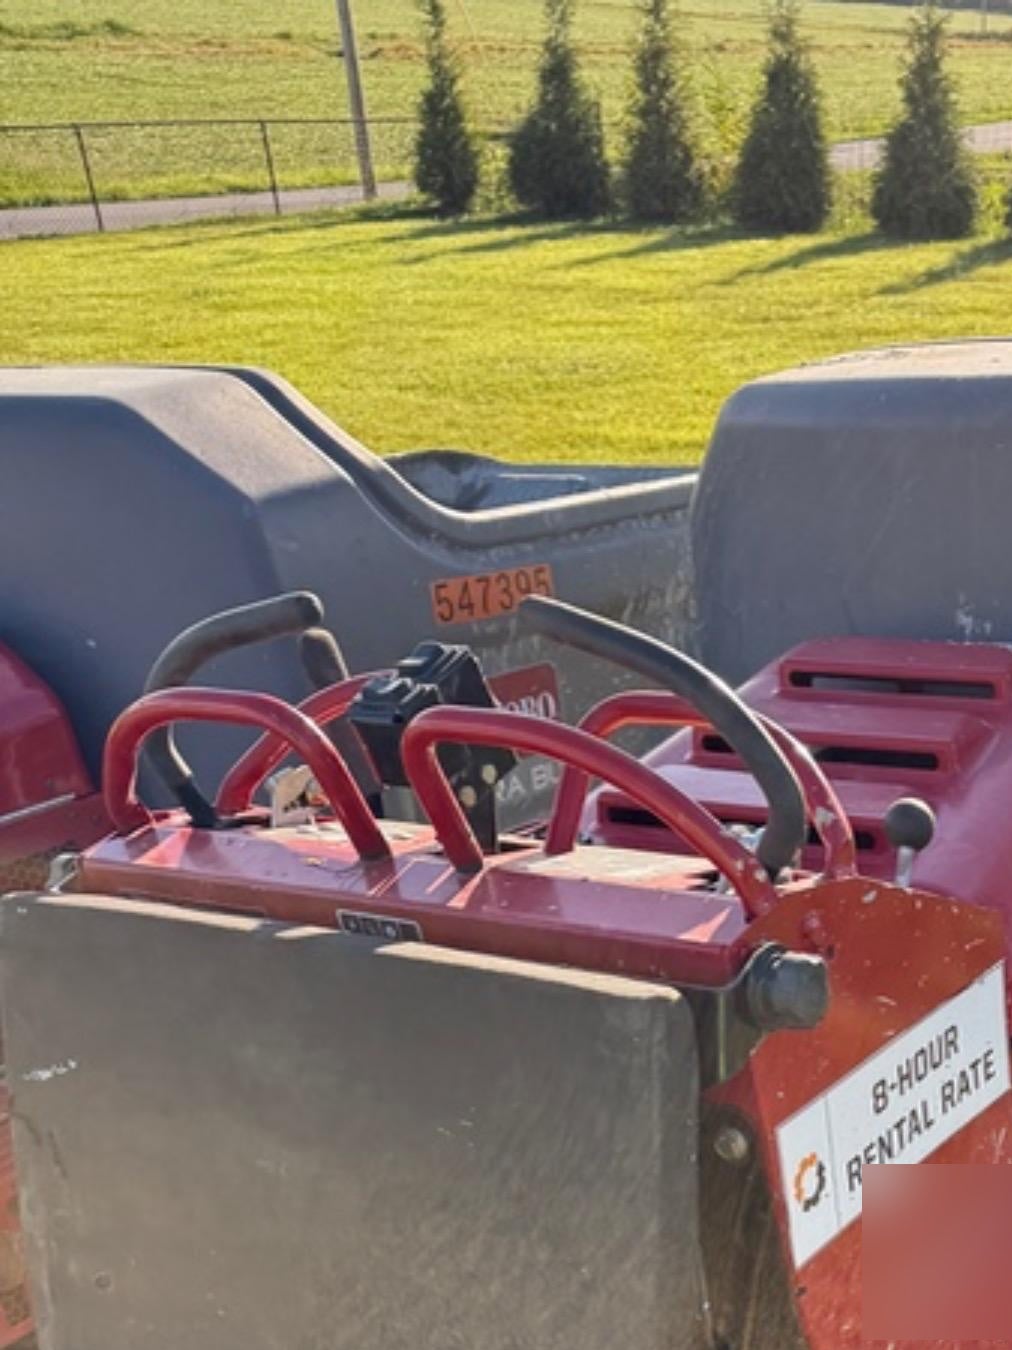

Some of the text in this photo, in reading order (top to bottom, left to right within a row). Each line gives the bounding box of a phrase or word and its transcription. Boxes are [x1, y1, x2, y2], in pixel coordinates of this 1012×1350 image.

[433, 566, 550, 622] 547395
[871, 1025, 960, 1114] 8-HOUR
[941, 1049, 997, 1115] RATE
